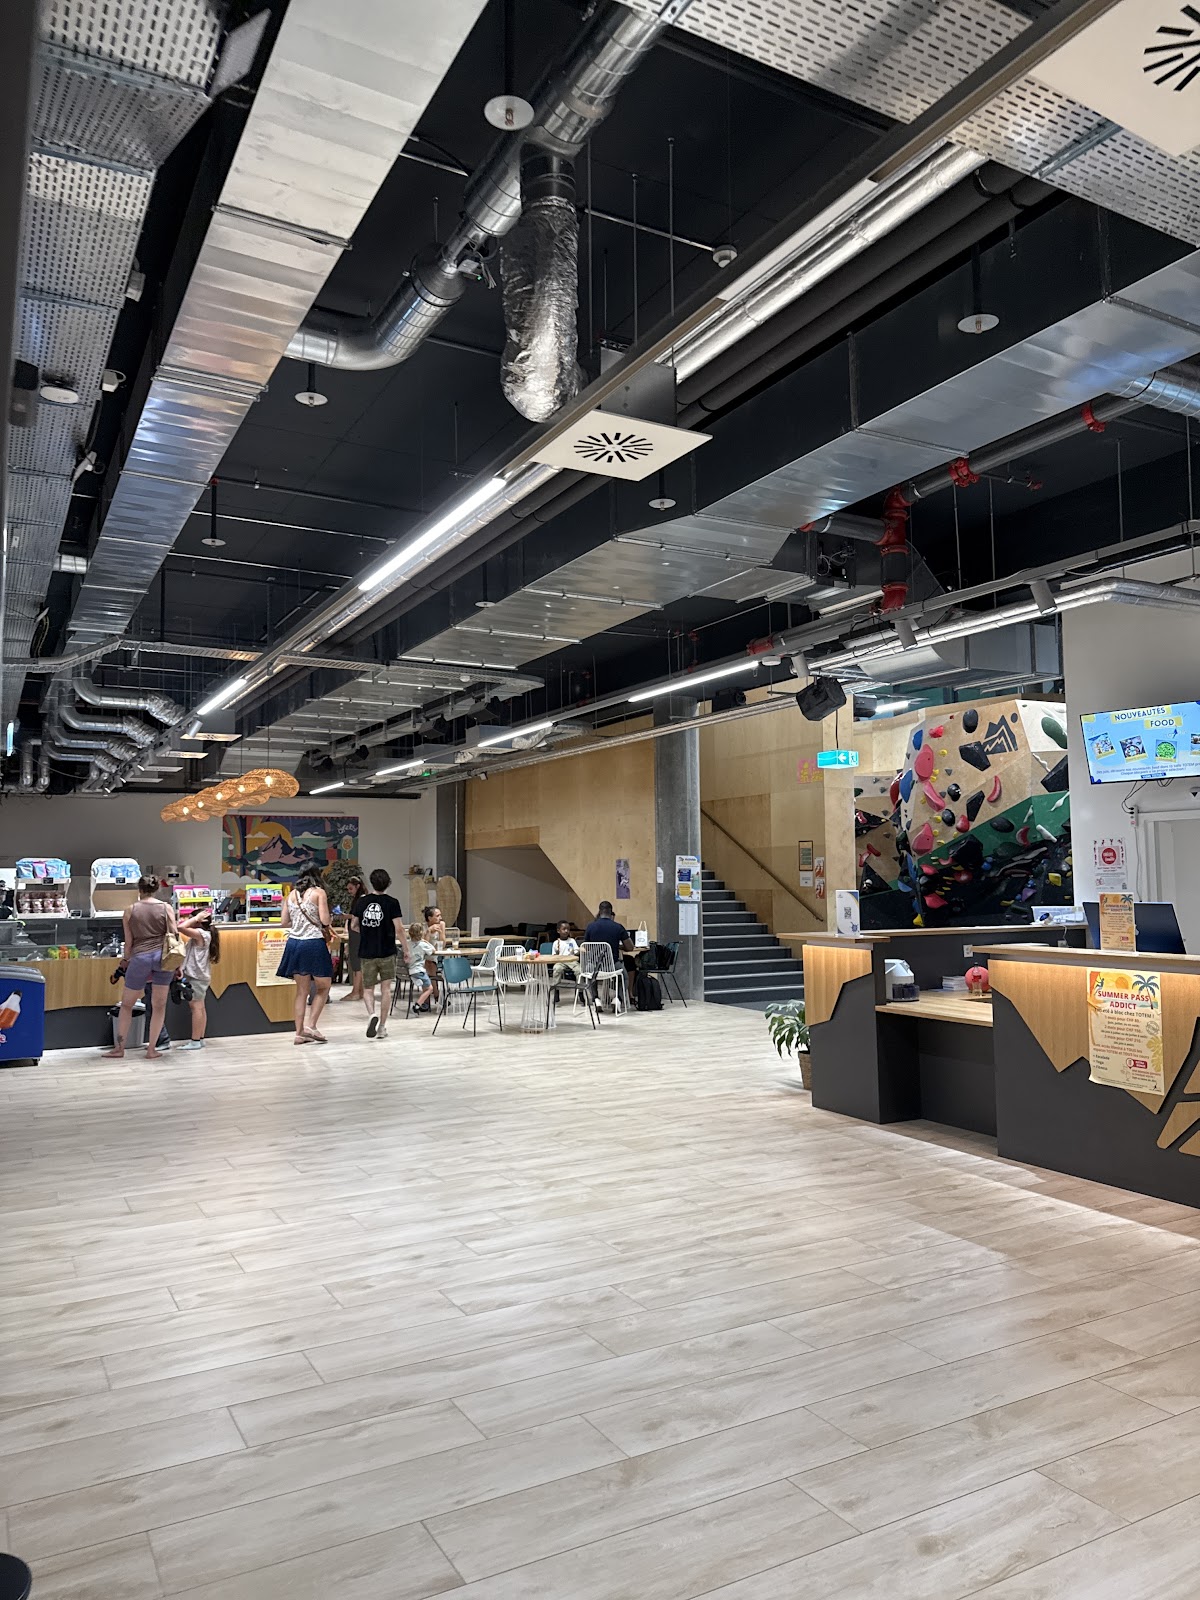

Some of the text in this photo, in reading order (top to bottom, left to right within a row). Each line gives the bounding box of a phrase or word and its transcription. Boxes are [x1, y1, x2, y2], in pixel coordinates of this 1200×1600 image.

[1150, 719, 1175, 728] FOOD
[1097, 990, 1149, 1002] SUMMER PASS
[1109, 1001, 1137, 1010] ADDICT
